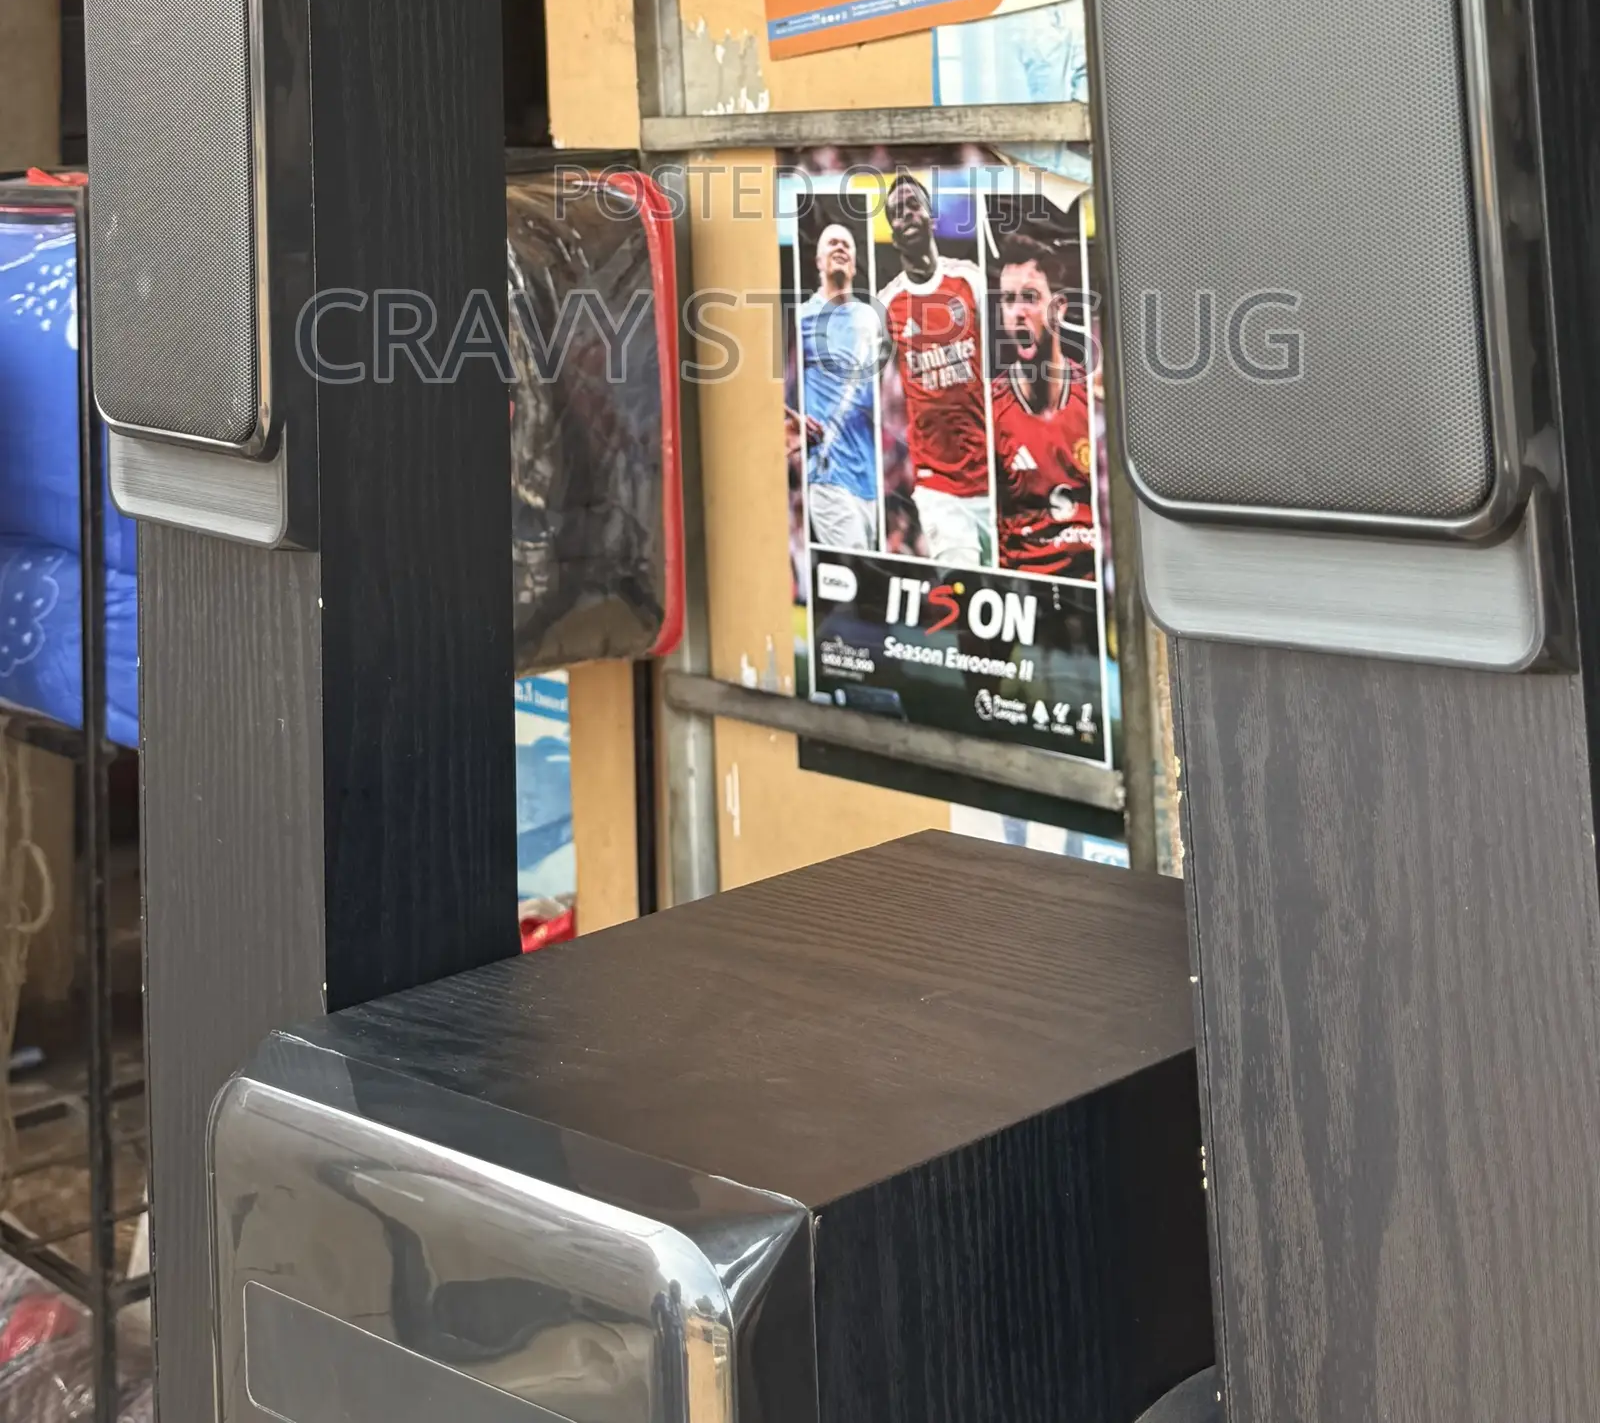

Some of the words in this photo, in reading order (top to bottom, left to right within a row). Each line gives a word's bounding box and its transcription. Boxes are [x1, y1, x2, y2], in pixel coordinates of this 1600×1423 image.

[905, 337, 977, 373] Emirates
[885, 576, 961, 636] IT'S
[967, 588, 1037, 646] ON
[883, 635, 943, 667] Season
